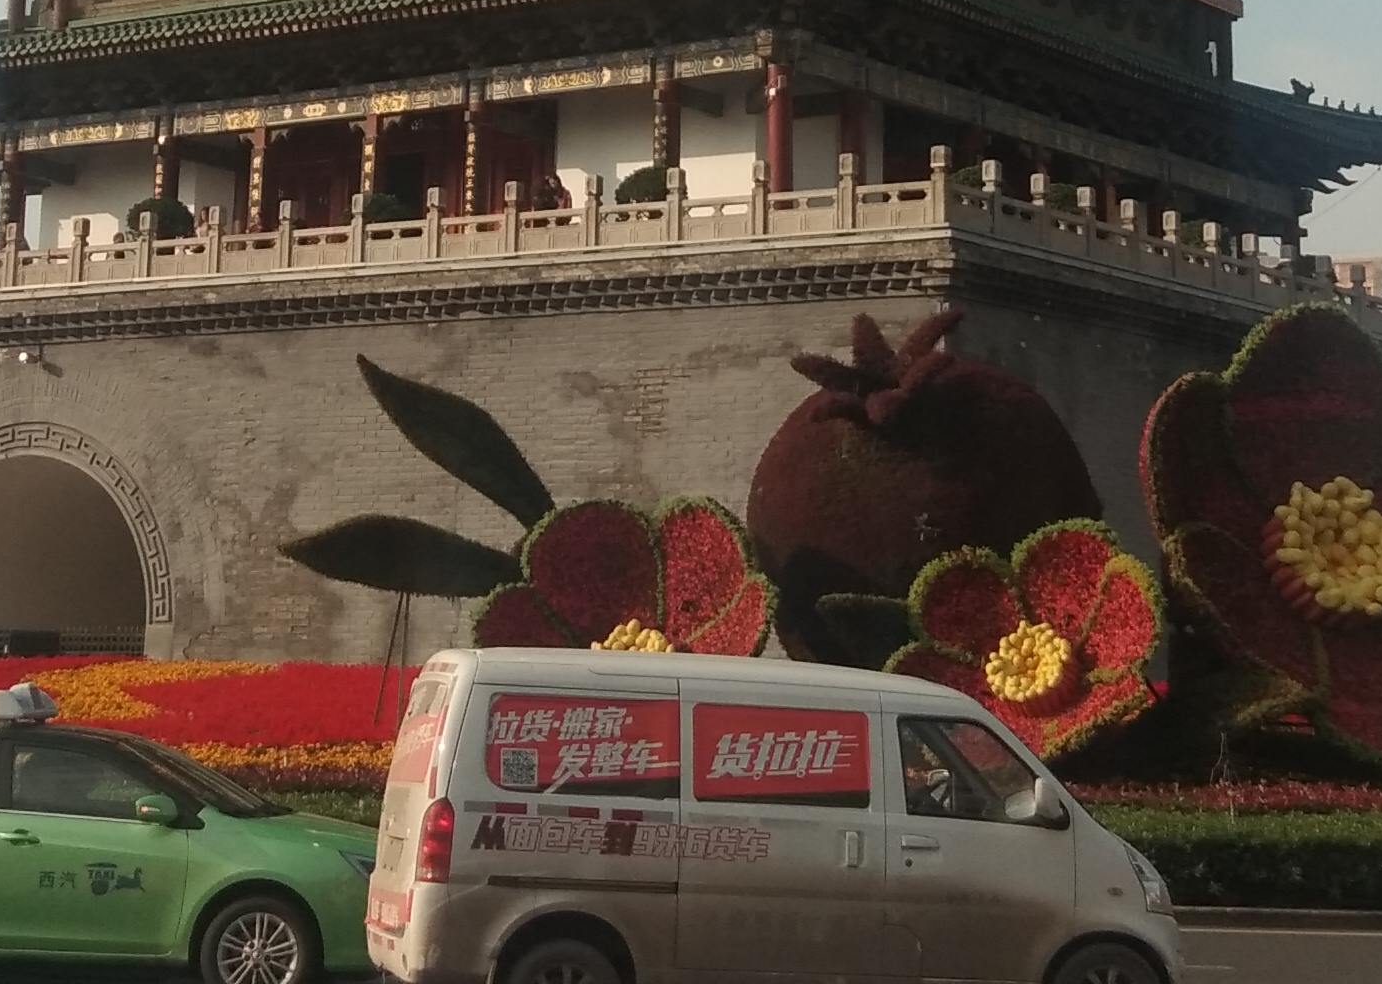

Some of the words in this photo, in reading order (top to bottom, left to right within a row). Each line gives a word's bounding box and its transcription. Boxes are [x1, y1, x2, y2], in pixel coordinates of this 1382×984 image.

[551, 739, 669, 780] 发整车
[706, 729, 857, 781] 货拉拉
[471, 815, 771, 862] 从面包车到9米6货车
